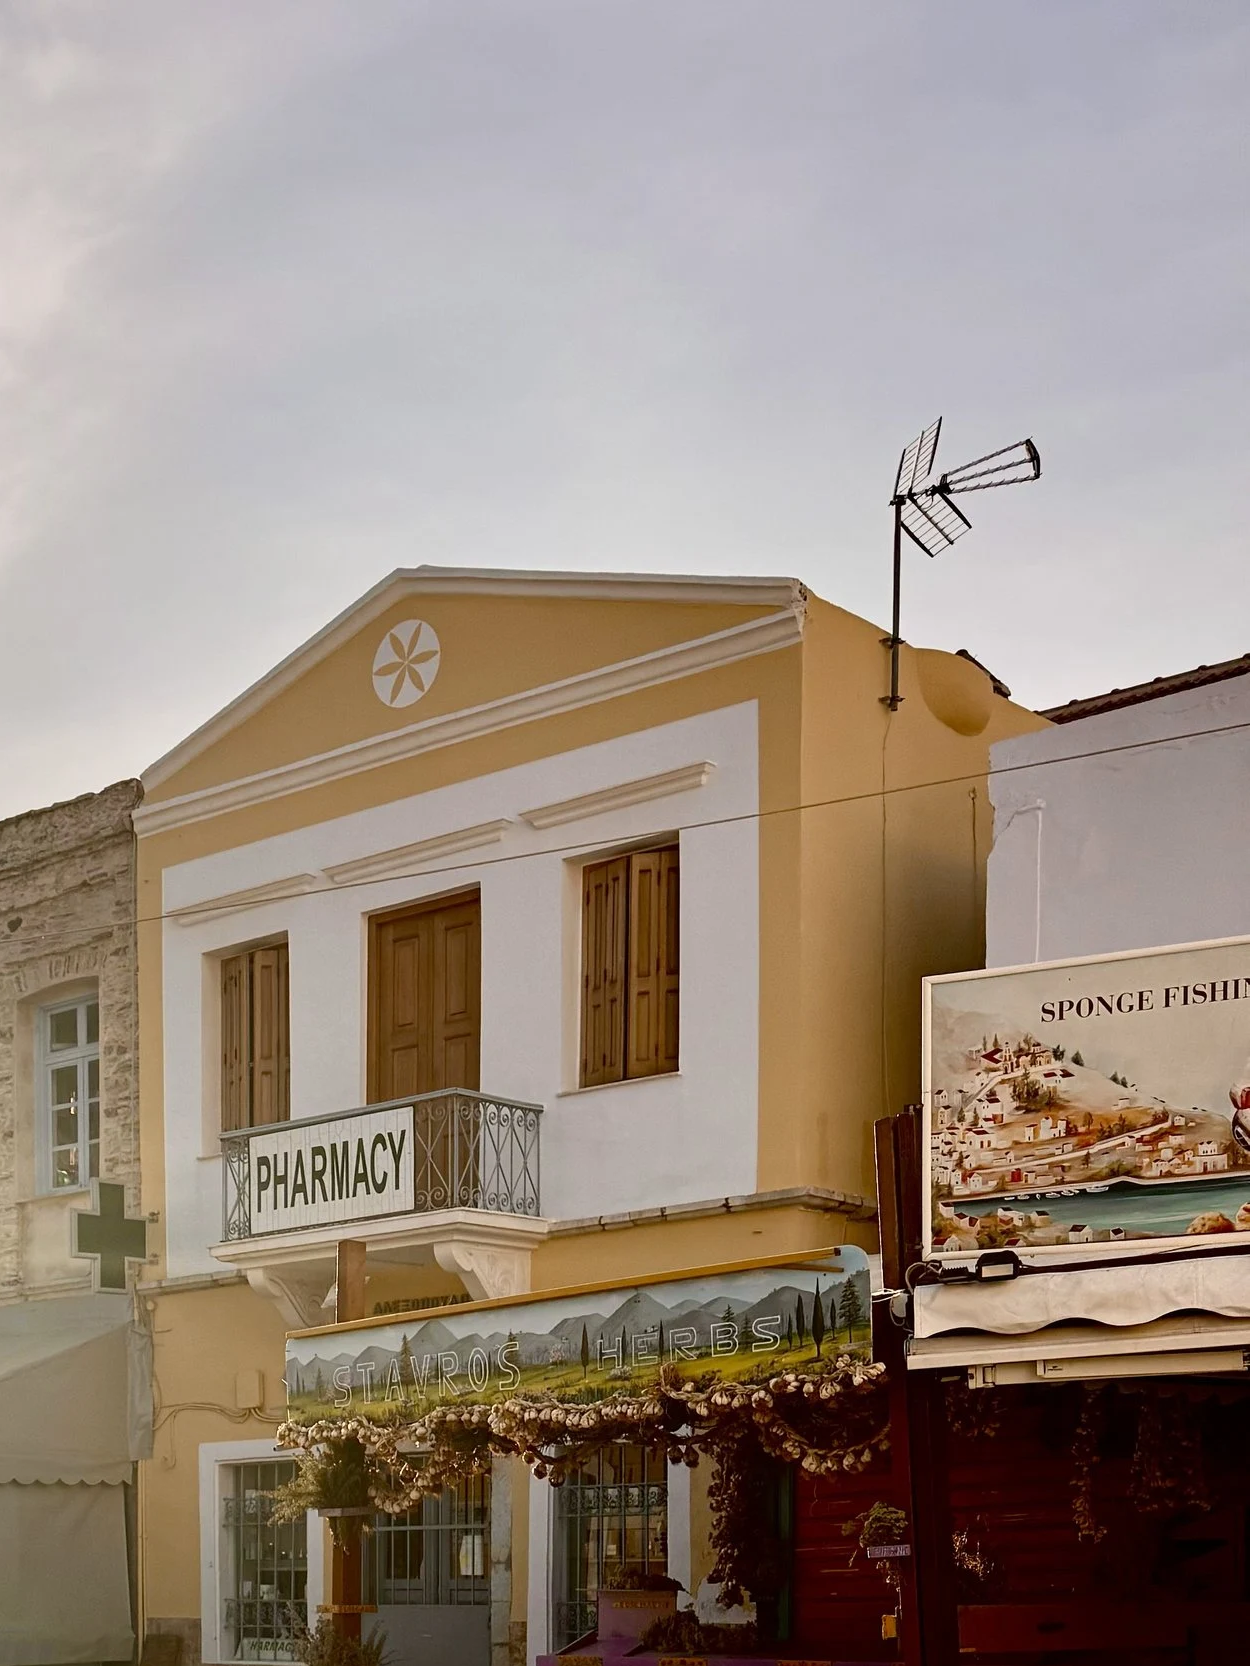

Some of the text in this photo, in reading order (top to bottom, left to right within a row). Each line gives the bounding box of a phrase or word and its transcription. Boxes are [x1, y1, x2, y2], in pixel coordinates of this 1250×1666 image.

[1040, 988, 1155, 1024] SPONGE
[255, 1128, 407, 1214] PHARMACY
[332, 1314, 782, 1409] STAVROS HERBS
